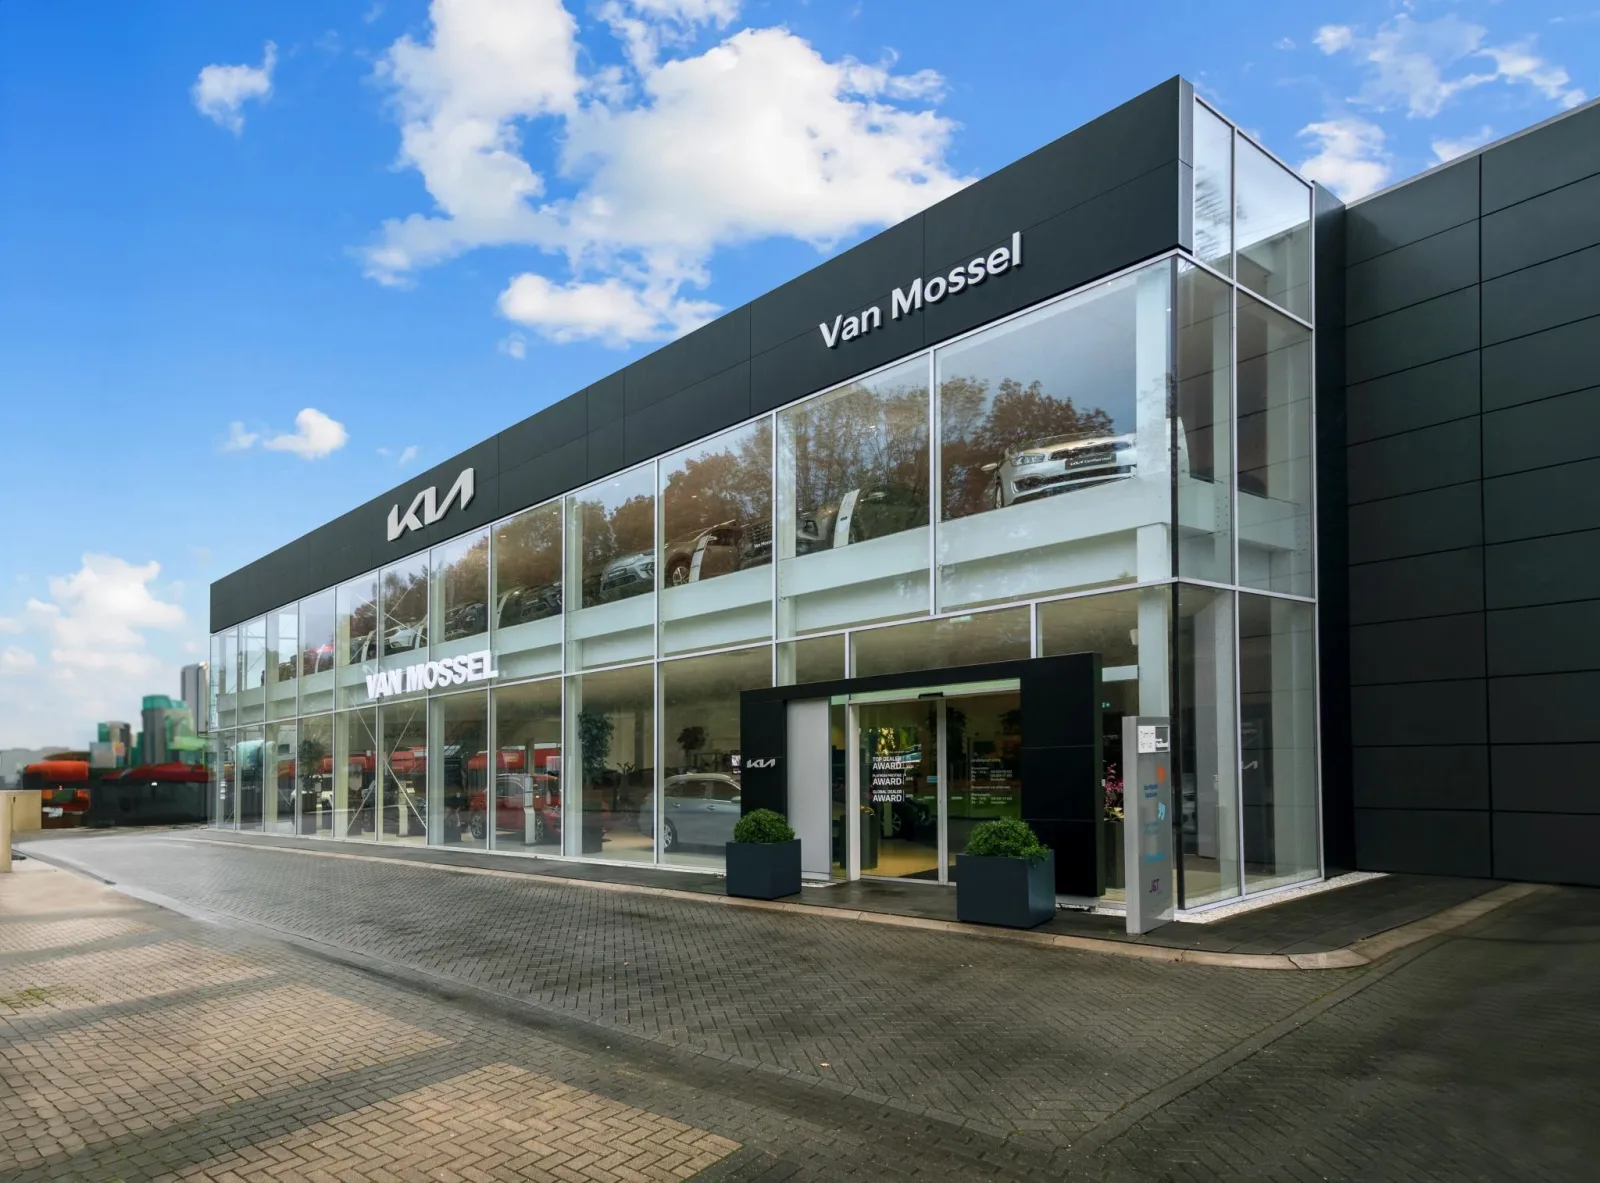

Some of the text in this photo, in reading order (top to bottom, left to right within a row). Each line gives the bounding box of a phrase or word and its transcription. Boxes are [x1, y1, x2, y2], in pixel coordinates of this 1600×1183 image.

[819, 231, 1021, 348] Van Mossel
[387, 467, 474, 542] KIA
[365, 649, 499, 699] VAN MOSSEL
[746, 758, 776, 769] KIA
[872, 762, 902, 770] AWARD
[872, 777, 902, 786] AWARD
[872, 794, 902, 802] AWARD
